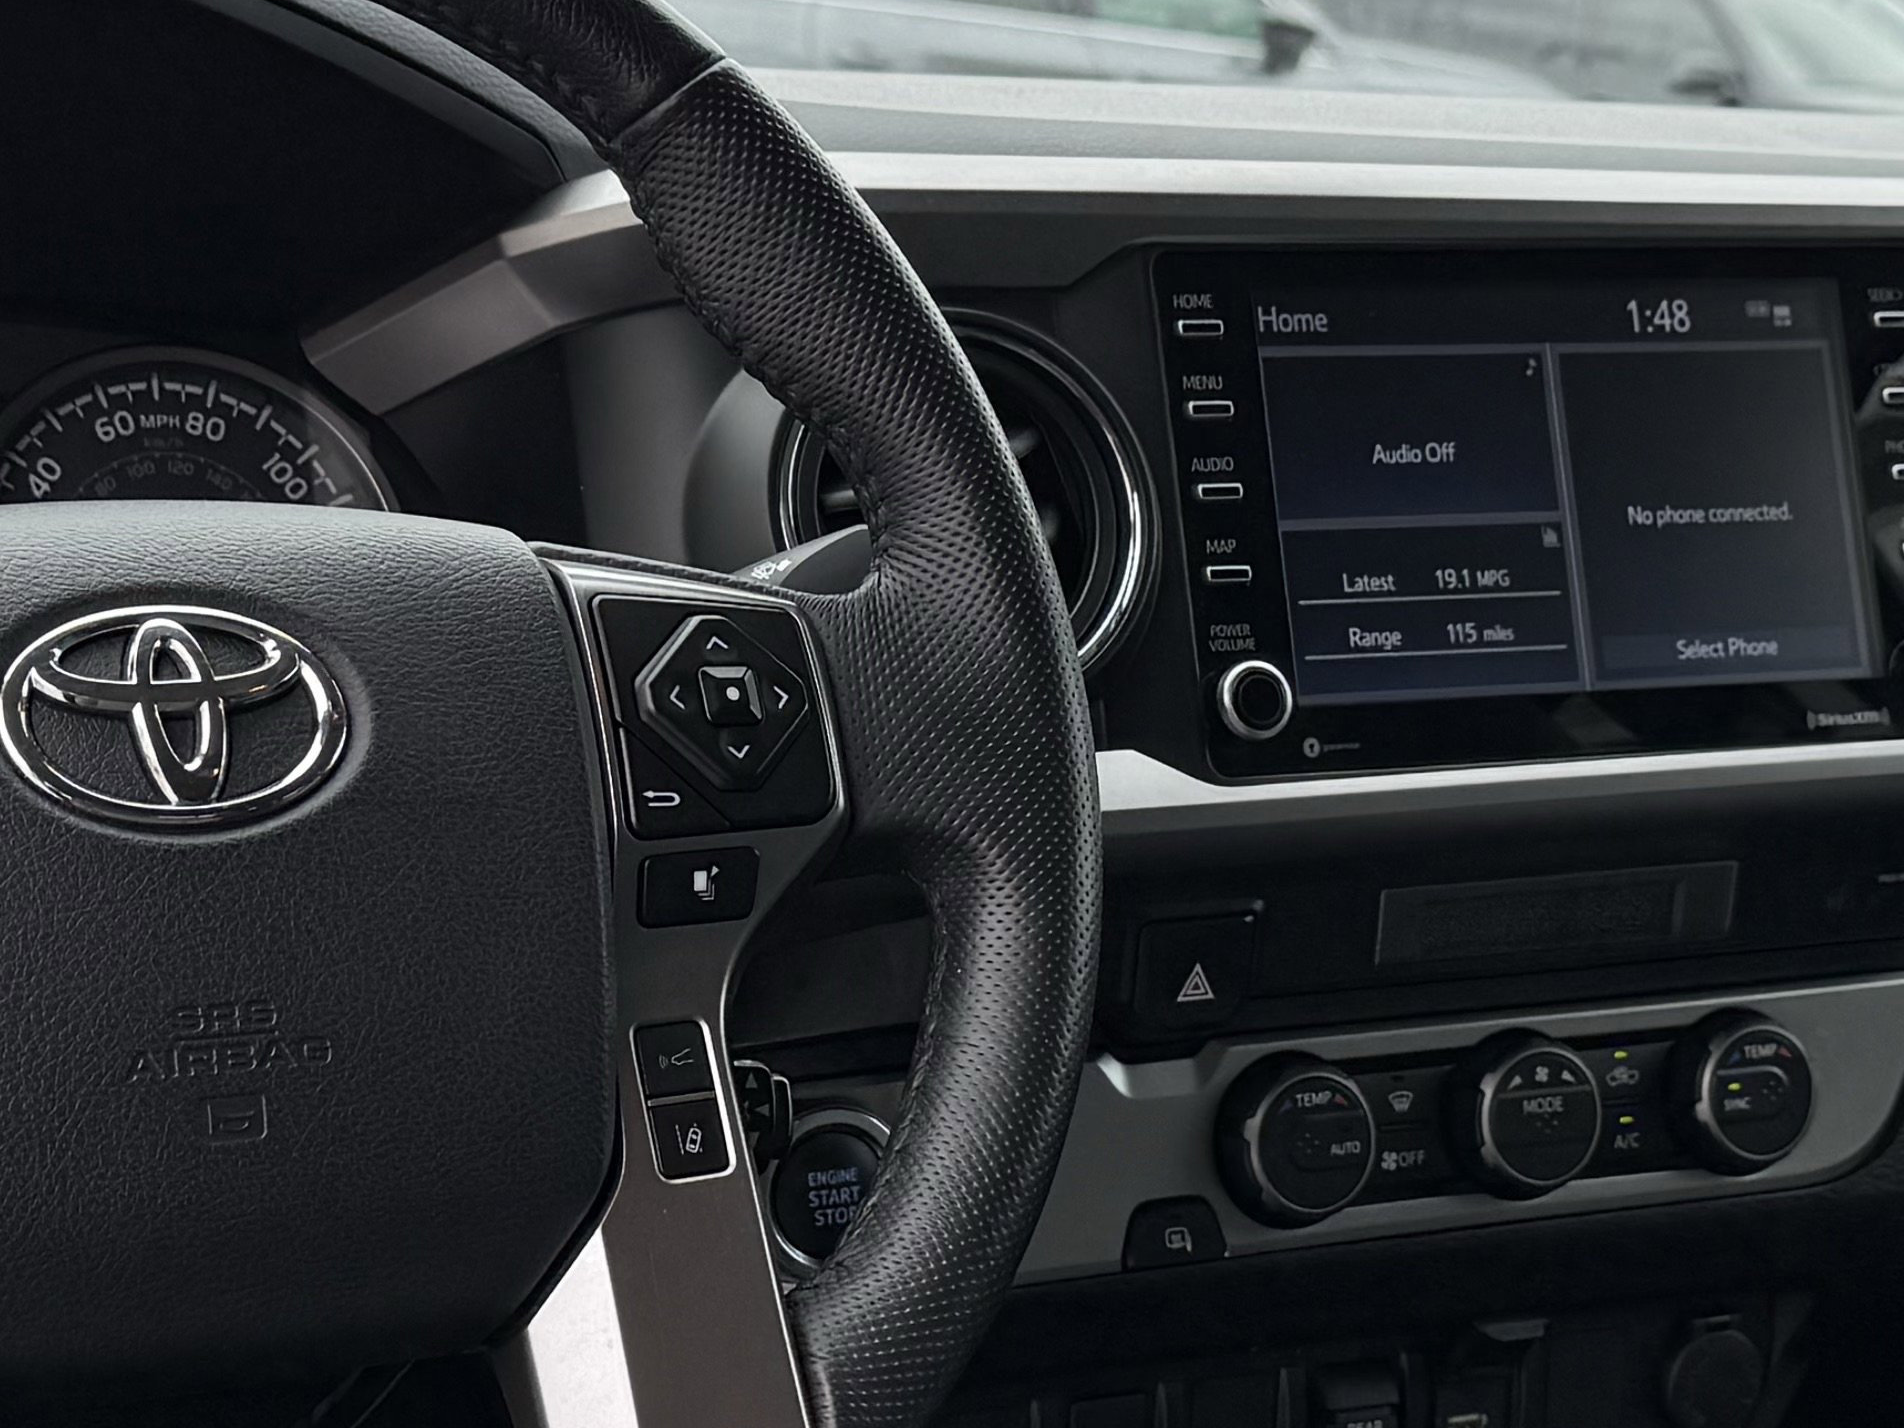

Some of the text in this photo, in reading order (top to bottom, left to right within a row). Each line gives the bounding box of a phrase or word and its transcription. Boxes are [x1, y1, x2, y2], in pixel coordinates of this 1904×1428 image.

[1172, 293, 1214, 310] HOME
[1257, 305, 1329, 335] Home
[1625, 297, 1692, 334] 1:48
[1182, 375, 1223, 391] MENU
[94, 409, 136, 444] 60
[139, 414, 181, 430] MPH
[184, 410, 227, 443] 80
[1372, 441, 1457, 465] Audio Off
[1191, 456, 1235, 473] AUDIO
[27, 456, 63, 500] 40
[261, 451, 309, 502] 100
[1627, 502, 1794, 529] No phone connected.
[1205, 538, 1238, 555] MAP
[1342, 568, 1512, 594] Latest 19.1 MPG
[1209, 623, 1252, 638] POWER
[1348, 623, 1515, 649] Range 115 miles
[1208, 638, 1257, 653] VOLUME
[1676, 636, 1779, 660] Select Phone
[176, 1000, 279, 1036] SRS
[1743, 1042, 1778, 1060] TEMP
[1295, 1090, 1334, 1109] TEMP
[1522, 1095, 1565, 1114] MODE
[1329, 1140, 1362, 1156] AUTO
[1613, 1131, 1641, 1150] A/C
[1397, 1150, 1426, 1167] OFF
[807, 1167, 859, 1188] ENGINE
[808, 1185, 862, 1208] START
